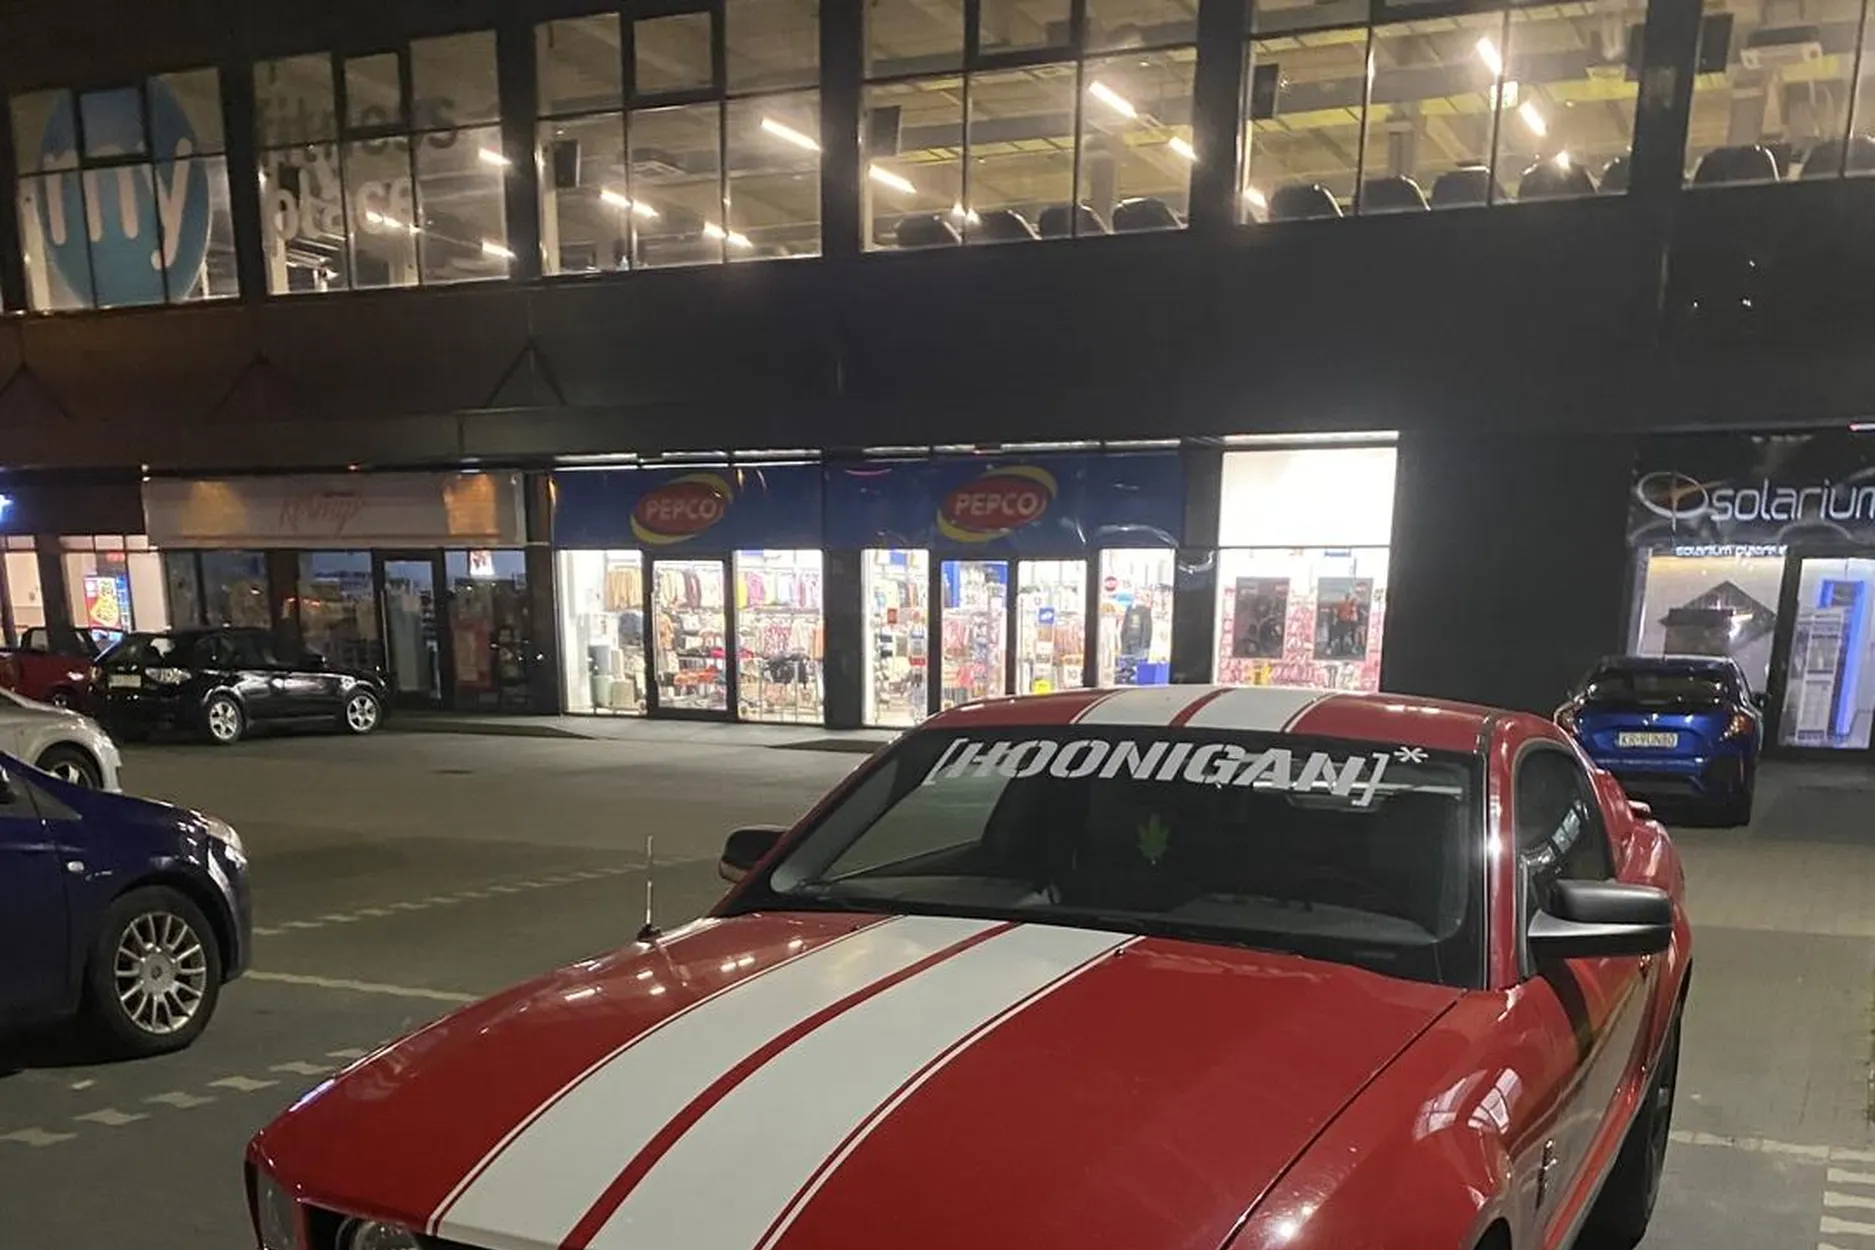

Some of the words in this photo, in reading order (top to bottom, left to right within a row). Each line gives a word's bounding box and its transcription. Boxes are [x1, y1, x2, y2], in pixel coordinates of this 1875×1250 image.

[44, 137, 193, 271] my
[644, 497, 718, 521] PEPCO
[955, 492, 1038, 517] PEPCO
